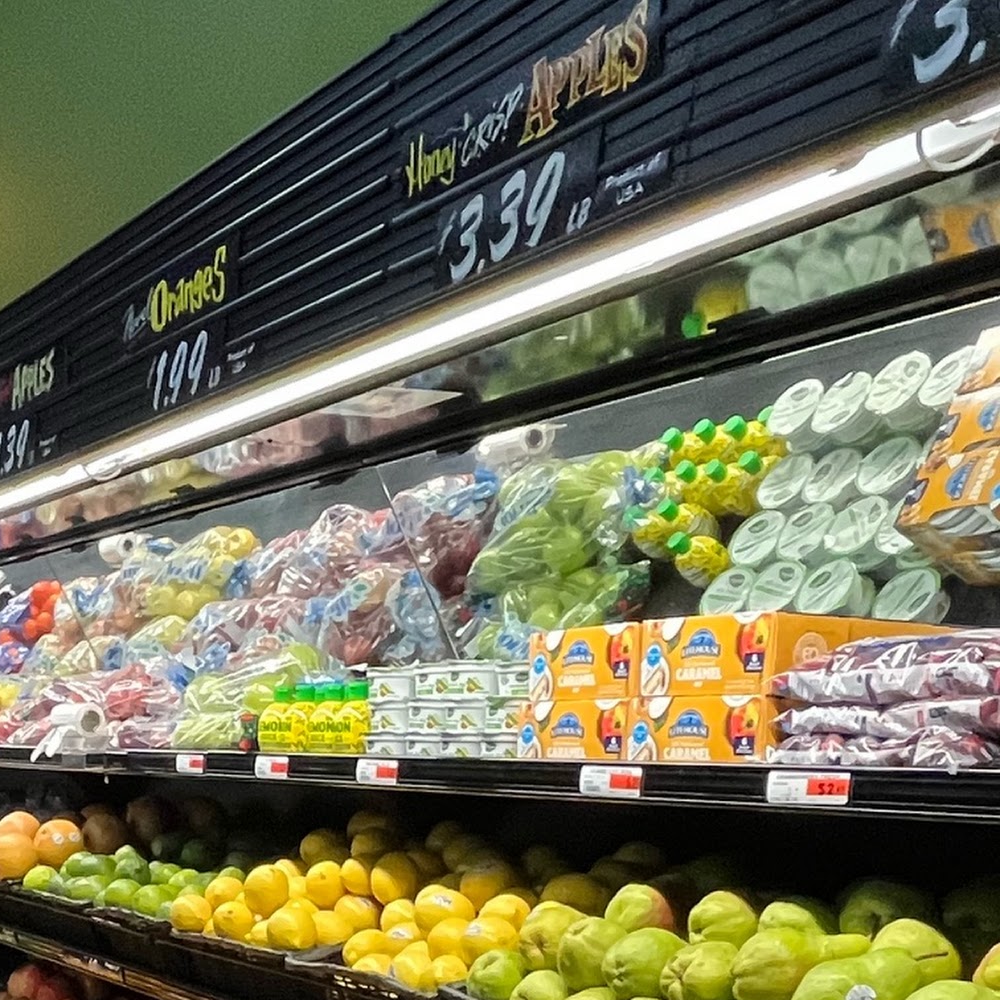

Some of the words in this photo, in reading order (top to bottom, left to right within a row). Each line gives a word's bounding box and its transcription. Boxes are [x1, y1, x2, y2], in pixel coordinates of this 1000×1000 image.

[517, 0, 648, 147] APPLES
[153, 329, 209, 411] 1.99
[675, 665, 723, 682] CARAMEL
